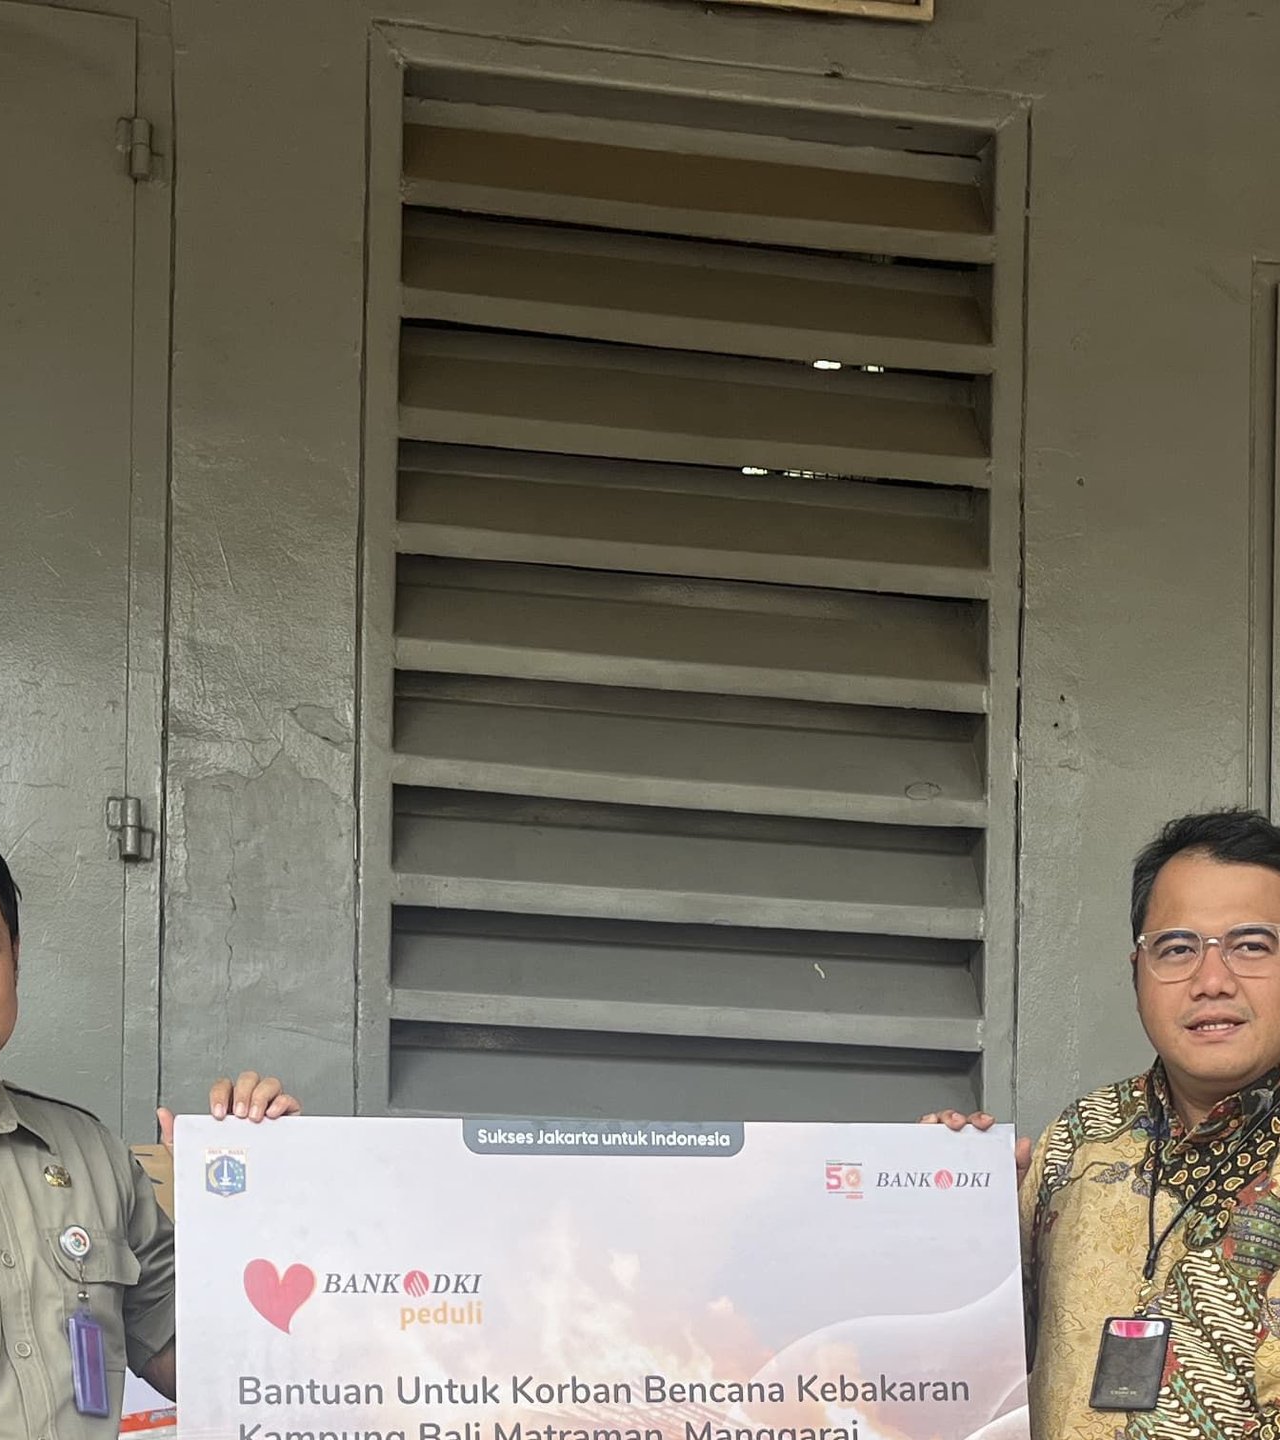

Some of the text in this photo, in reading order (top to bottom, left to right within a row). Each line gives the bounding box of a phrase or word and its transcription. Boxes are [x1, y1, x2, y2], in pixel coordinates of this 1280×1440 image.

[477, 1129, 731, 1147] Sukses Jakarta untuk Indonesia
[876, 1171, 992, 1188] BANK DKI
[322, 1273, 483, 1294] BANK DKI
[400, 1301, 483, 1331] peduli
[238, 1374, 970, 1405] Bantuan Untuk Korban Bencana Kebakaran
